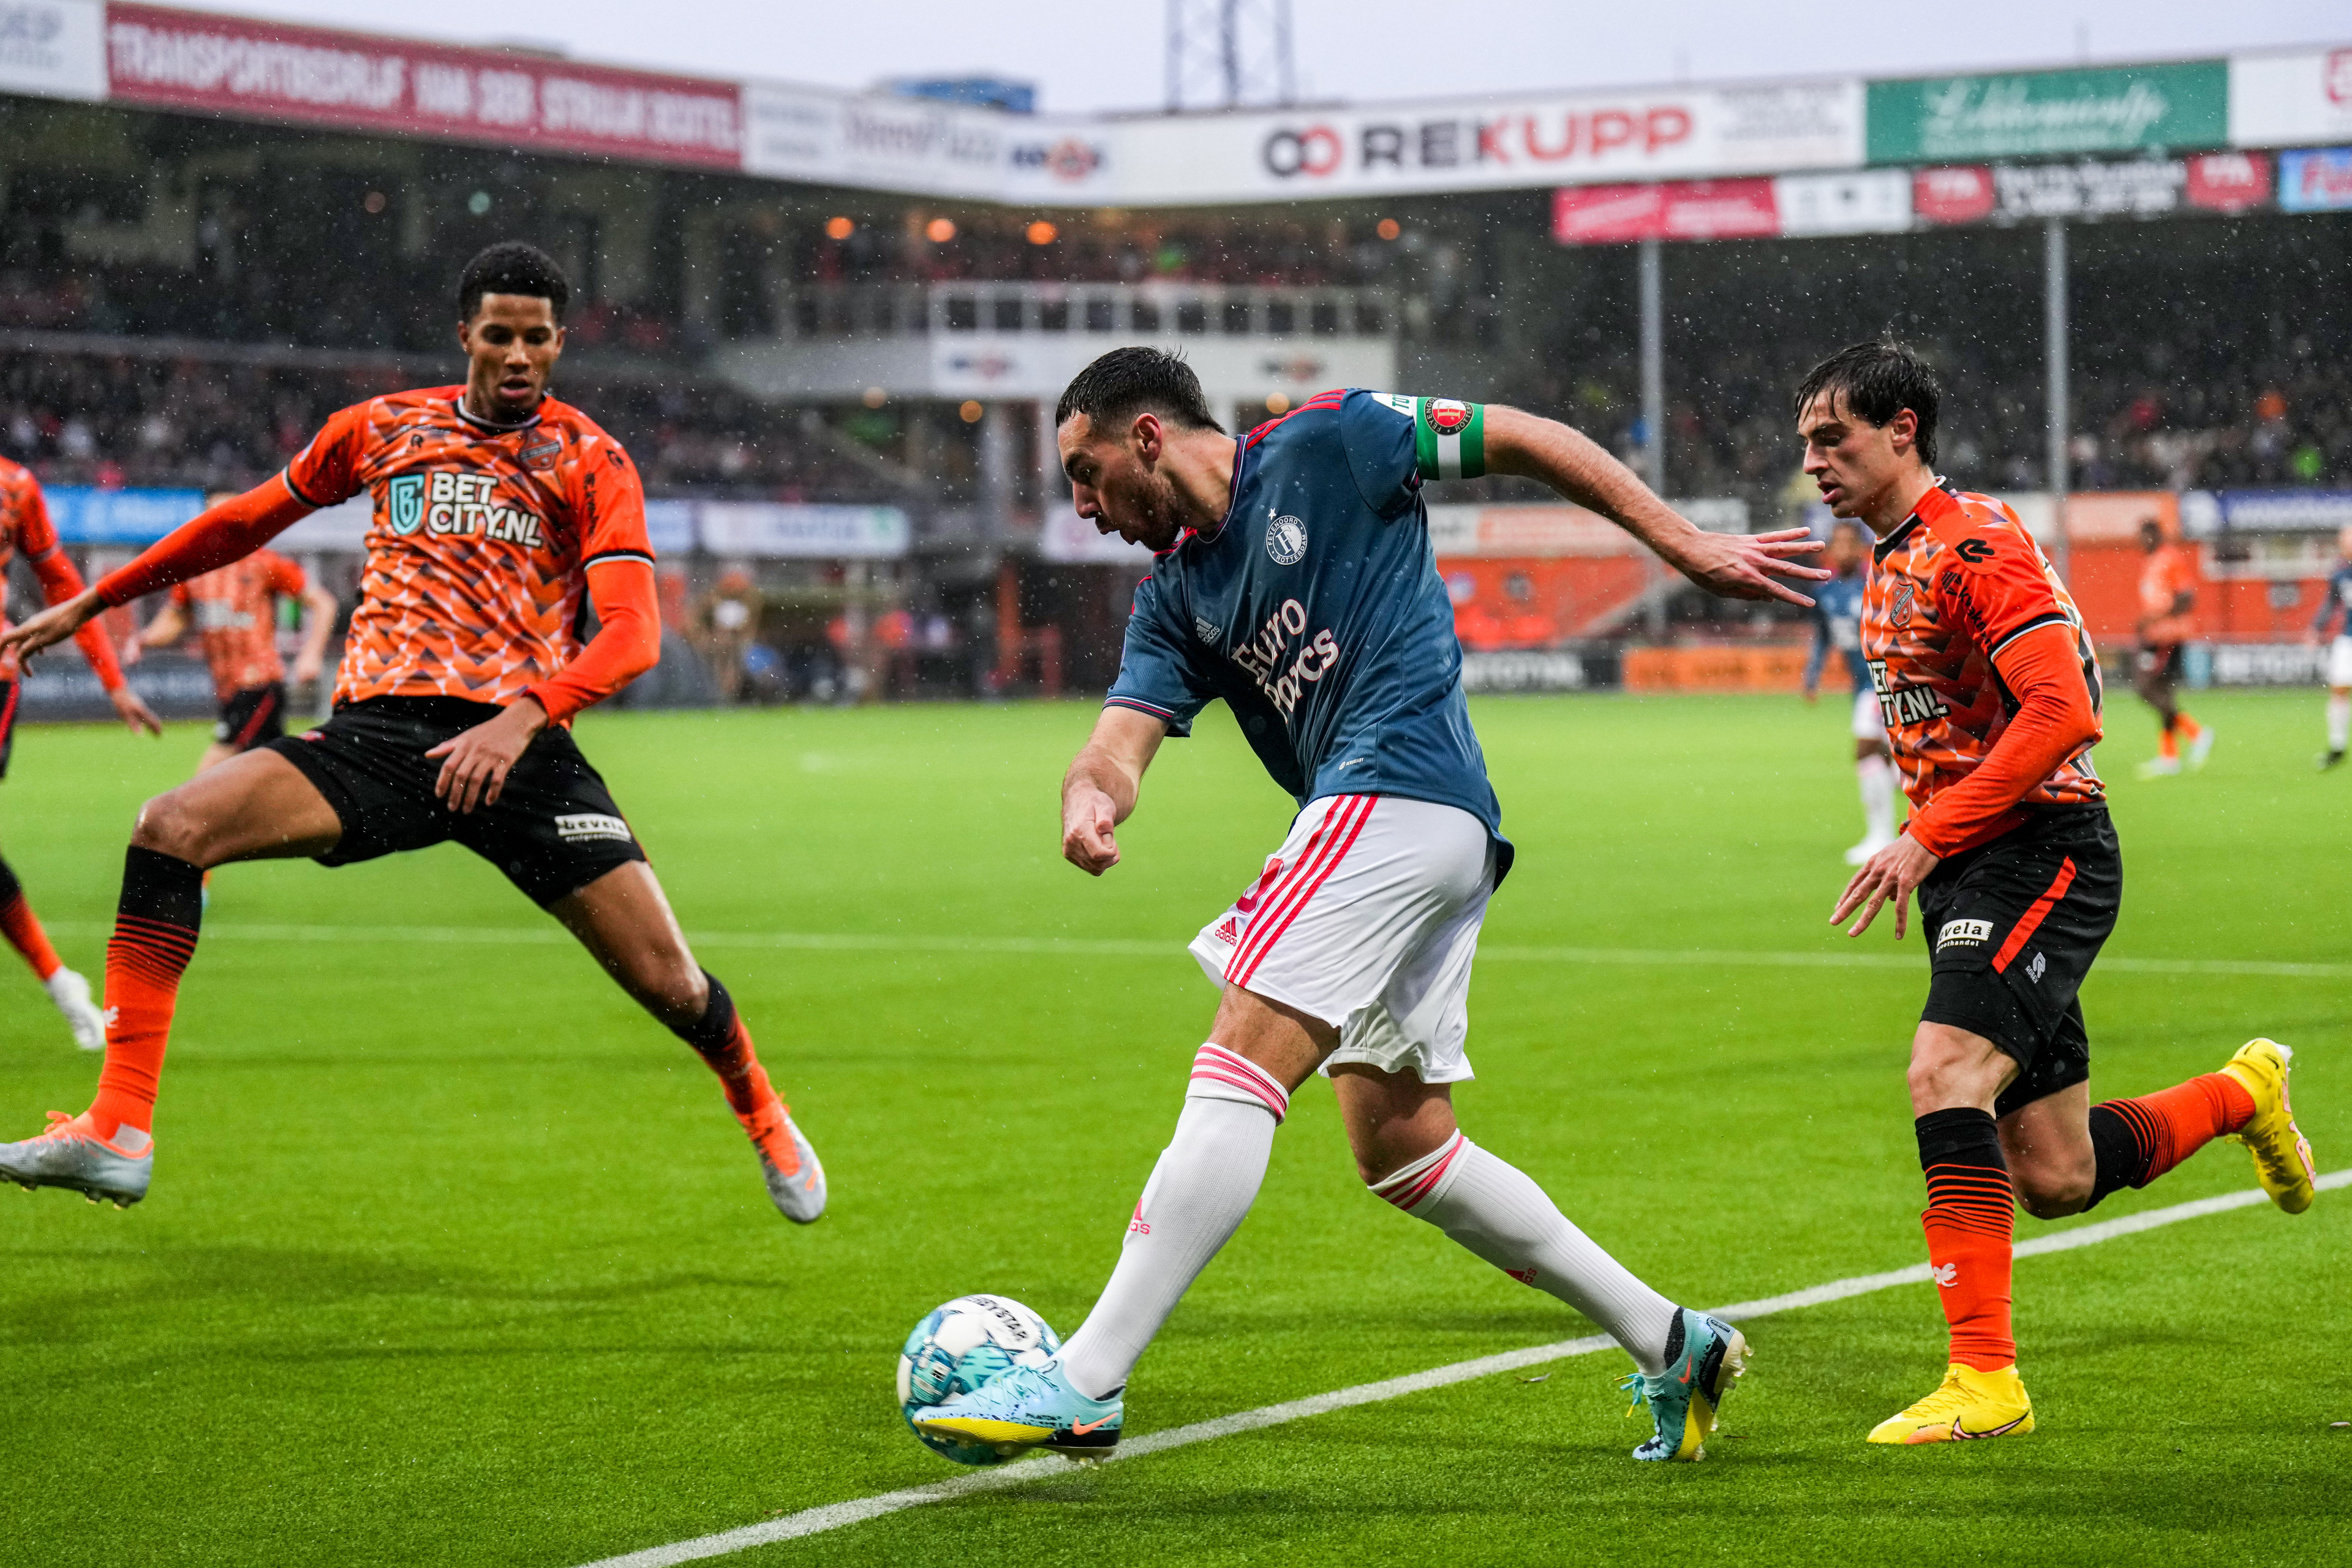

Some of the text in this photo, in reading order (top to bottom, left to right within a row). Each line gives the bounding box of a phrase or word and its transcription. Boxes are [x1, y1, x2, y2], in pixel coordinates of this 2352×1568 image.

[1361, 107, 1693, 170] REKUPP
[1427, 398, 1442, 432] FEYENOO
[432, 472, 499, 505] BET
[429, 503, 542, 548] CITY.NL
[1268, 517, 1298, 546] FEYENOORD
[1276, 534, 1306, 564] ROTTERDAM
[1867, 661, 1890, 693] ET
[1215, 929, 1237, 947] adidas
